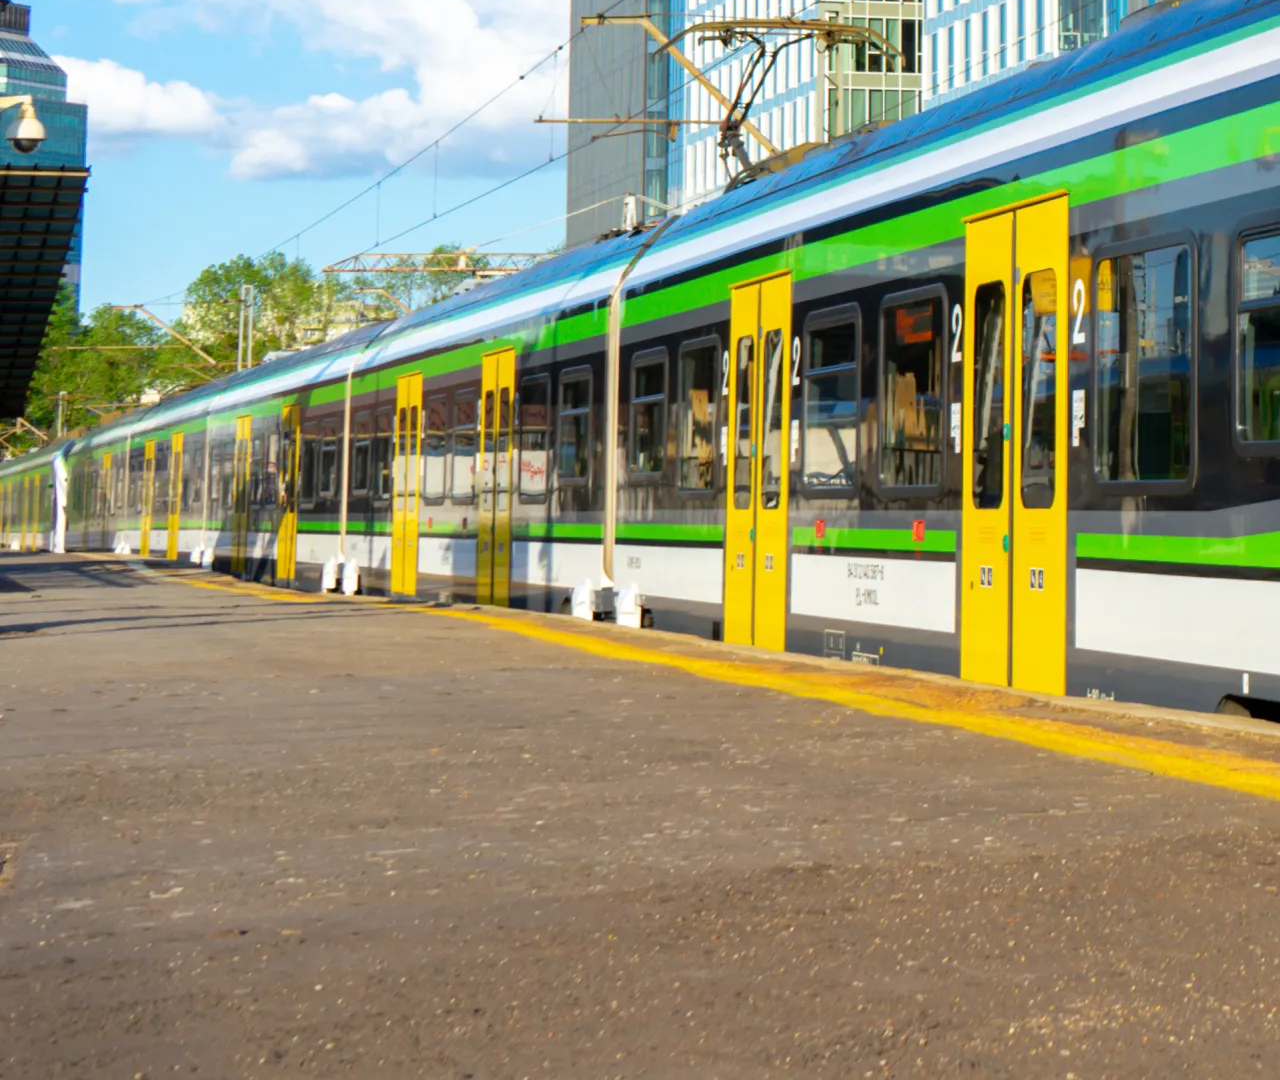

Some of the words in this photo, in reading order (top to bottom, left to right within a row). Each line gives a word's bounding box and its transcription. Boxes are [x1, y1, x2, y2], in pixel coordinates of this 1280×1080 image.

[951, 303, 963, 363] 2
[1072, 278, 1086, 345] 2
[721, 349, 730, 396] 2
[791, 336, 801, 386] 2
